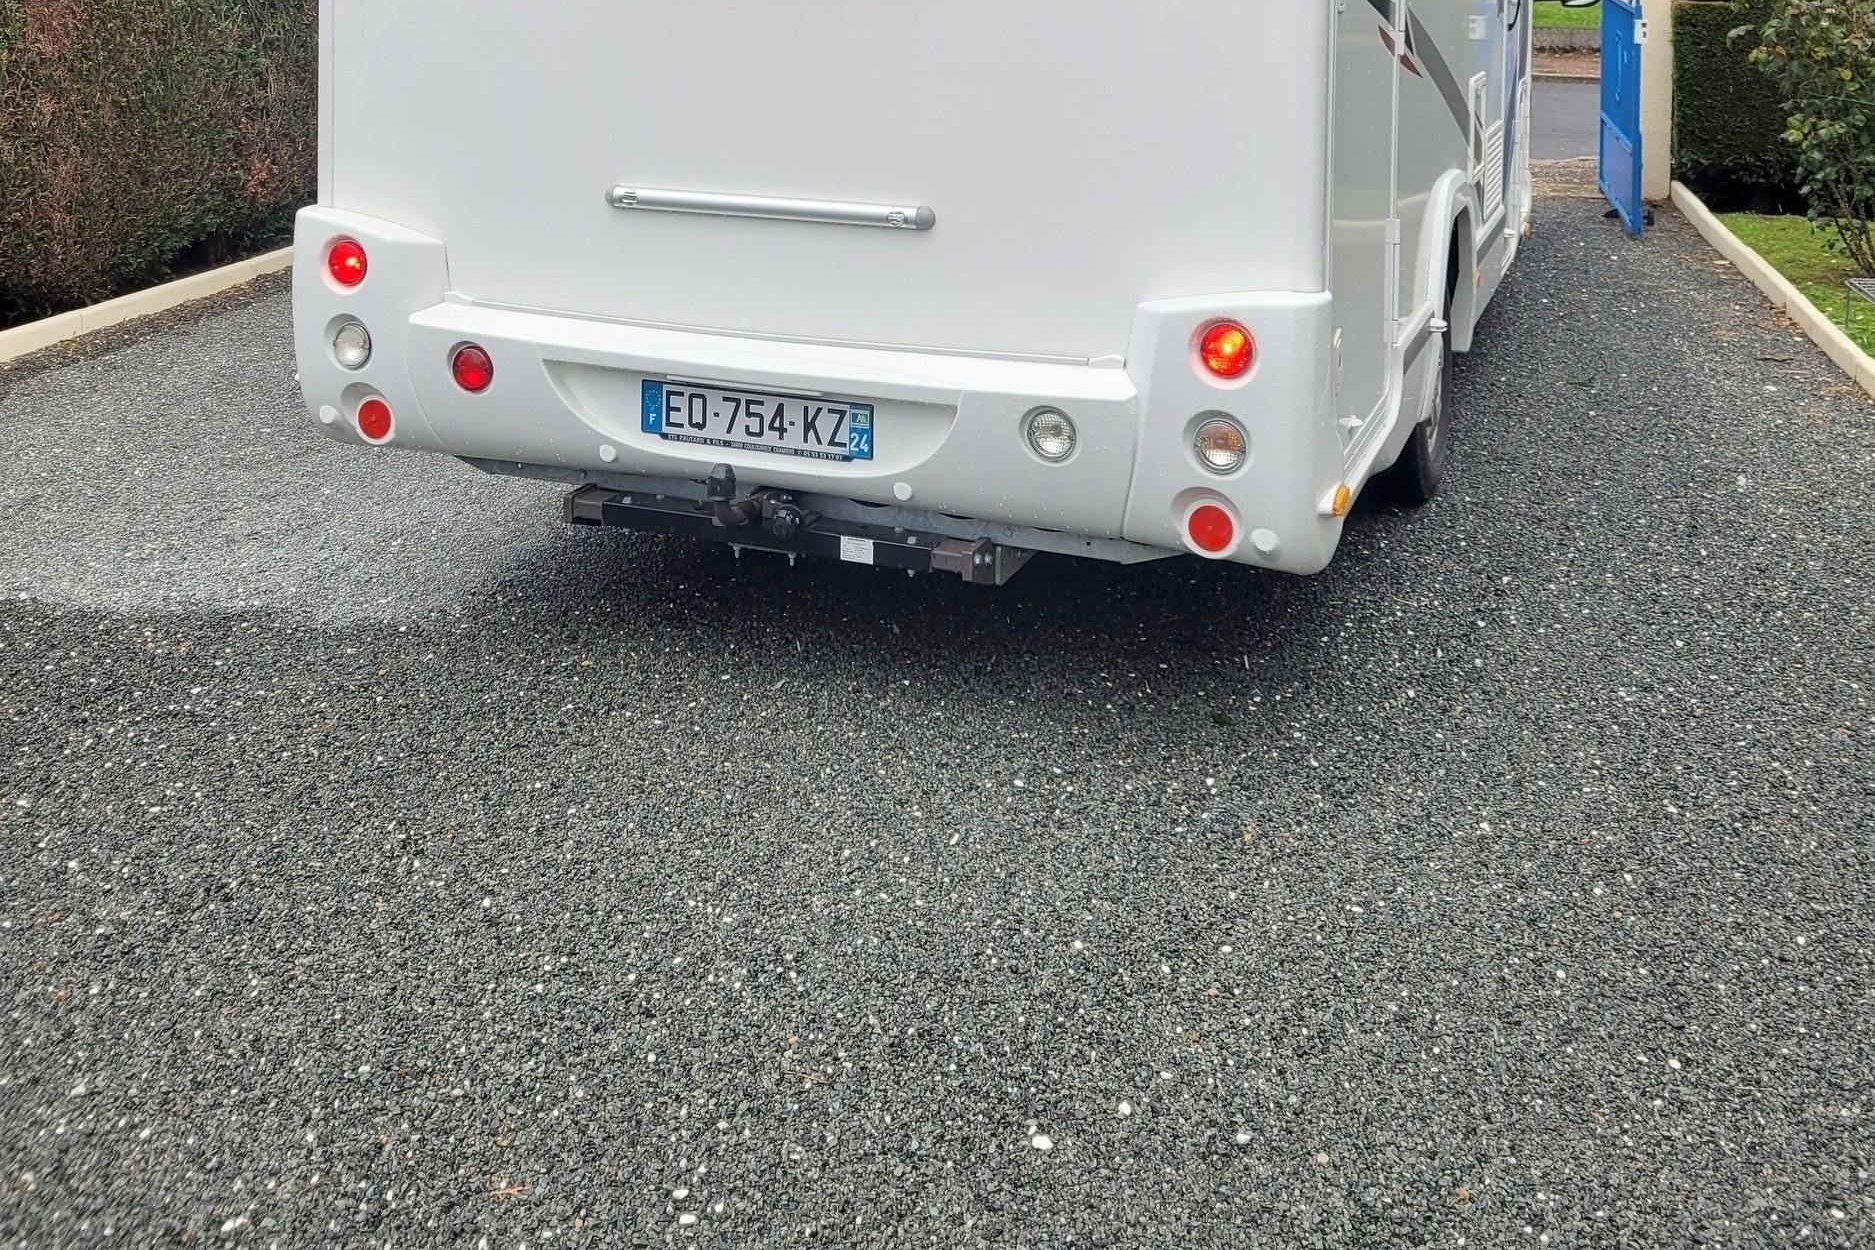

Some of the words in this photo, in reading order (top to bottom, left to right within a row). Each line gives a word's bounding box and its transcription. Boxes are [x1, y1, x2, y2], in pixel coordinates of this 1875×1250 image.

[649, 413, 656, 425] F
[665, 389, 848, 449] EQ-754-KZ
[850, 432, 869, 452] 24
[680, 435, 705, 444] PAUTARD
